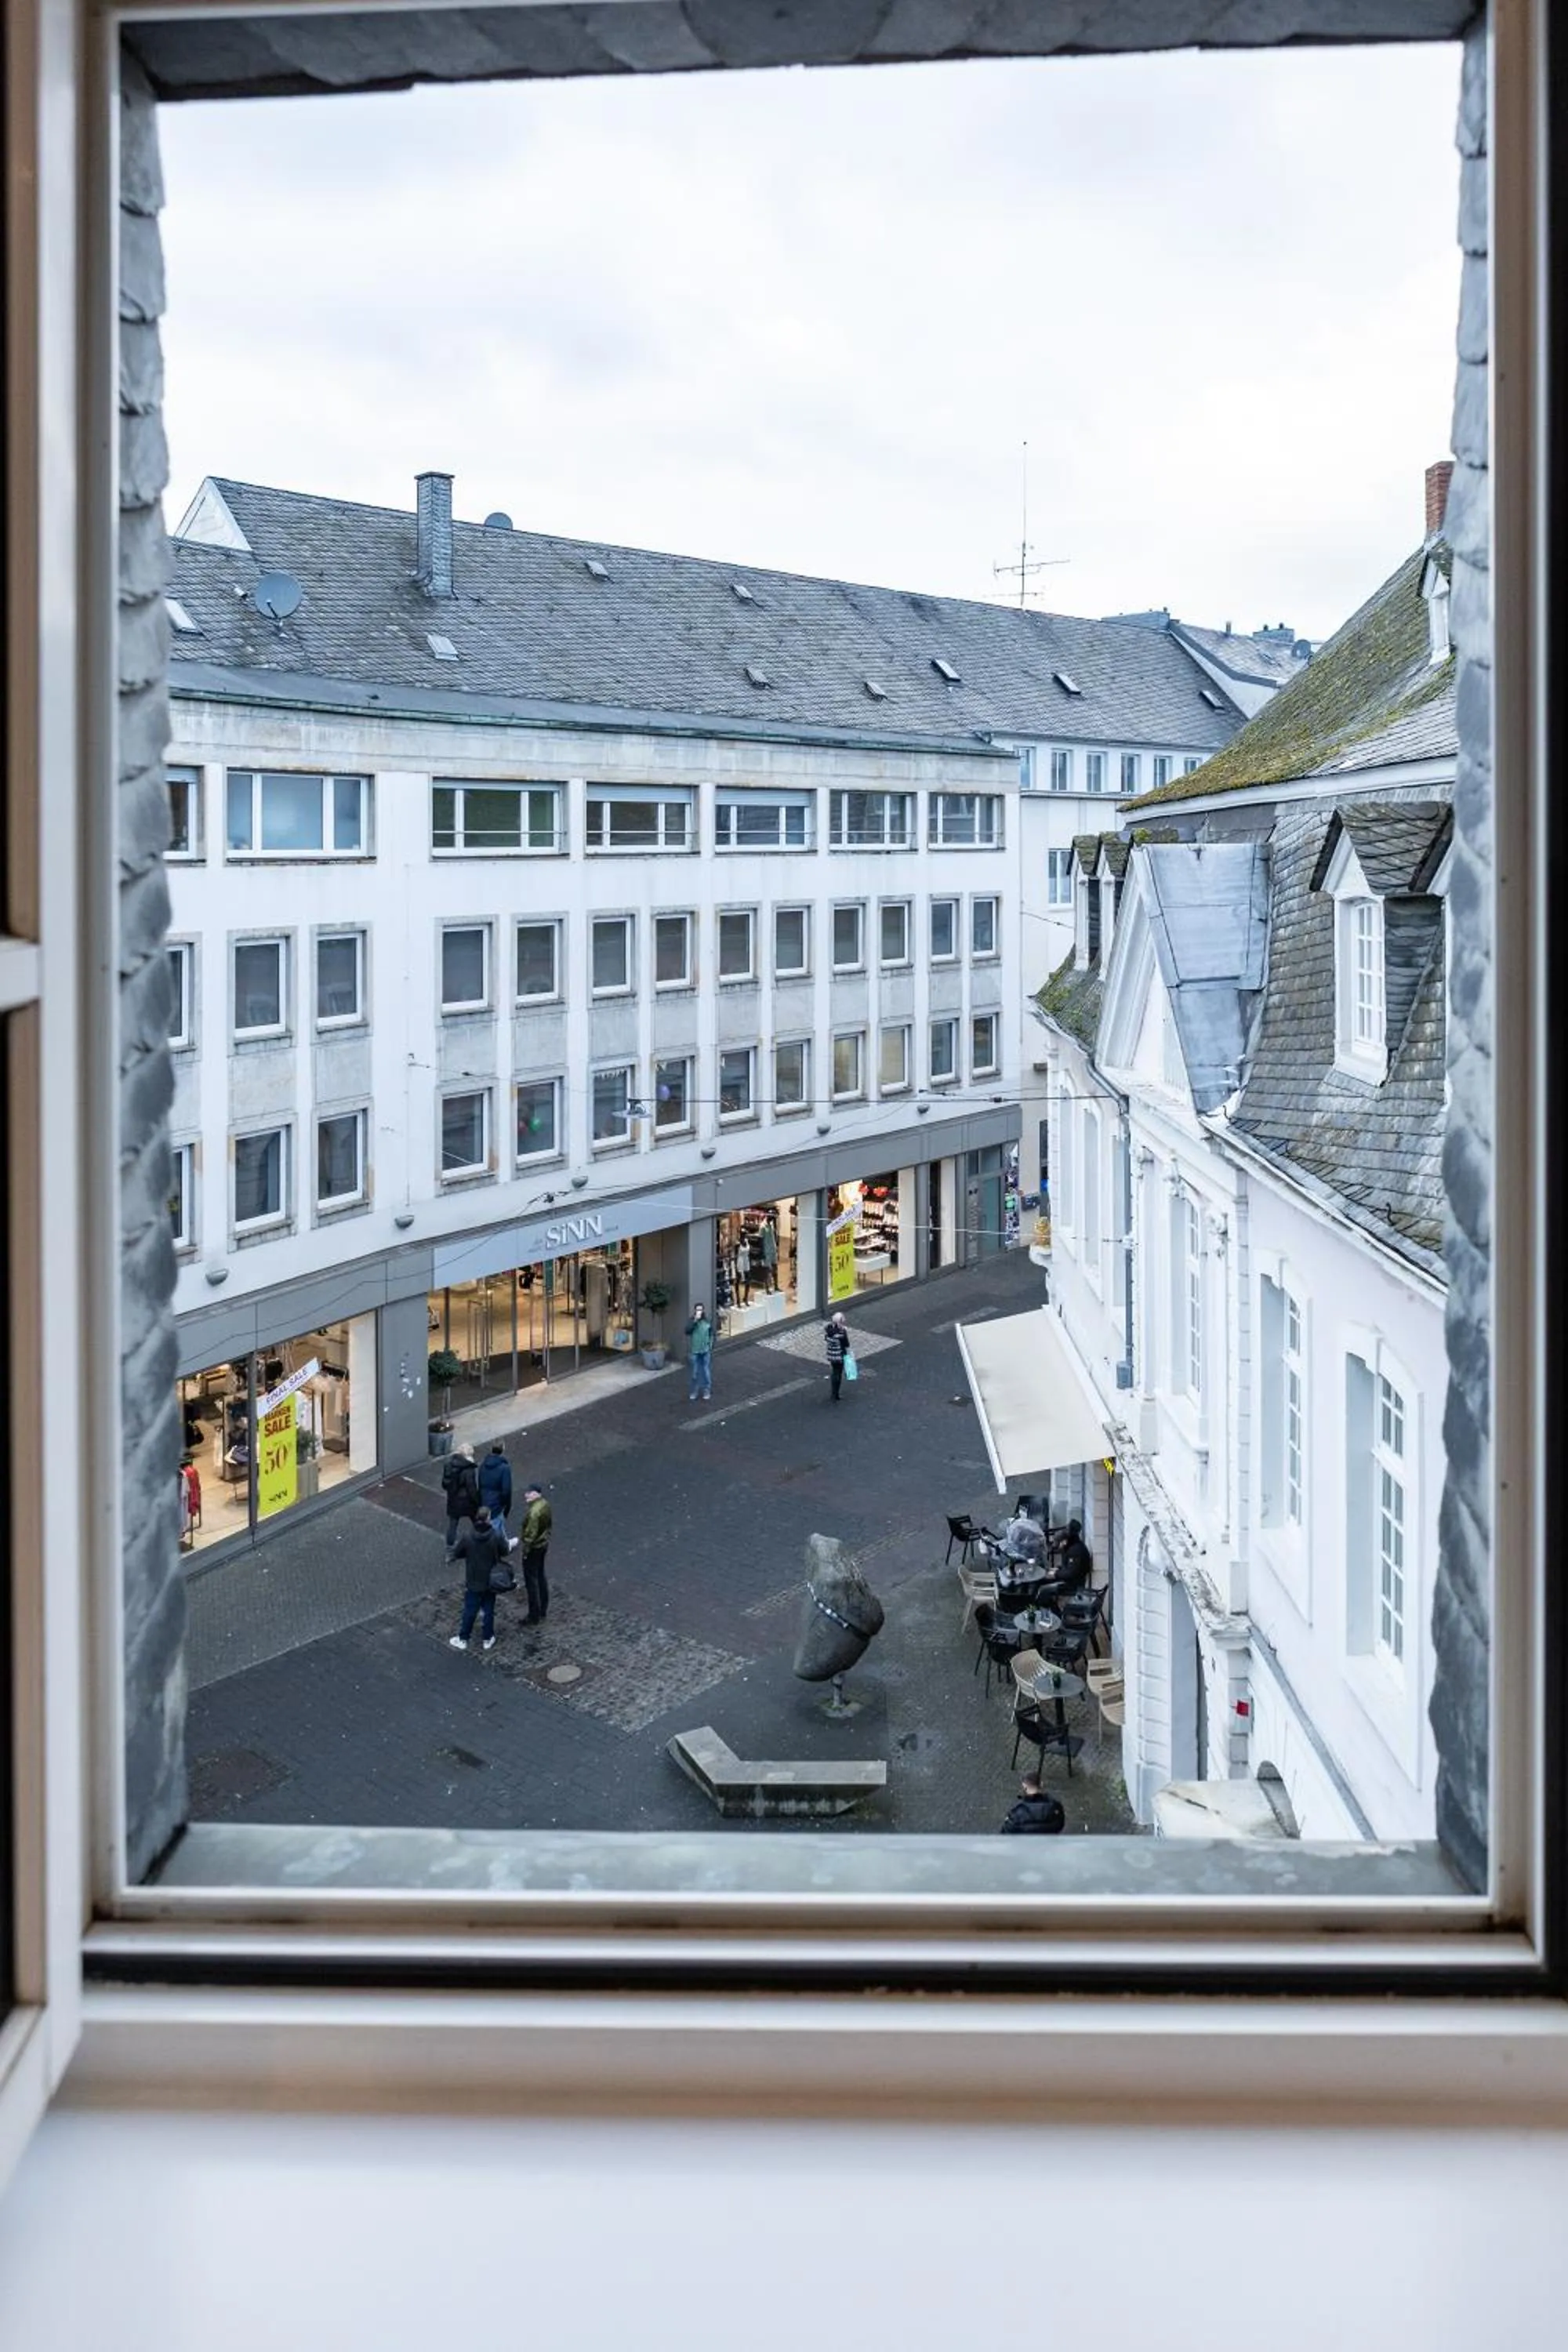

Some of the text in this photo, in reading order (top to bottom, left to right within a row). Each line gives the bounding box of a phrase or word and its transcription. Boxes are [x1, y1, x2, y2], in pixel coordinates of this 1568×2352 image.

[266, 1367, 307, 1404] FINAL SALE
[264, 1414, 291, 1438] SALE
[264, 1443, 288, 1475] 50
